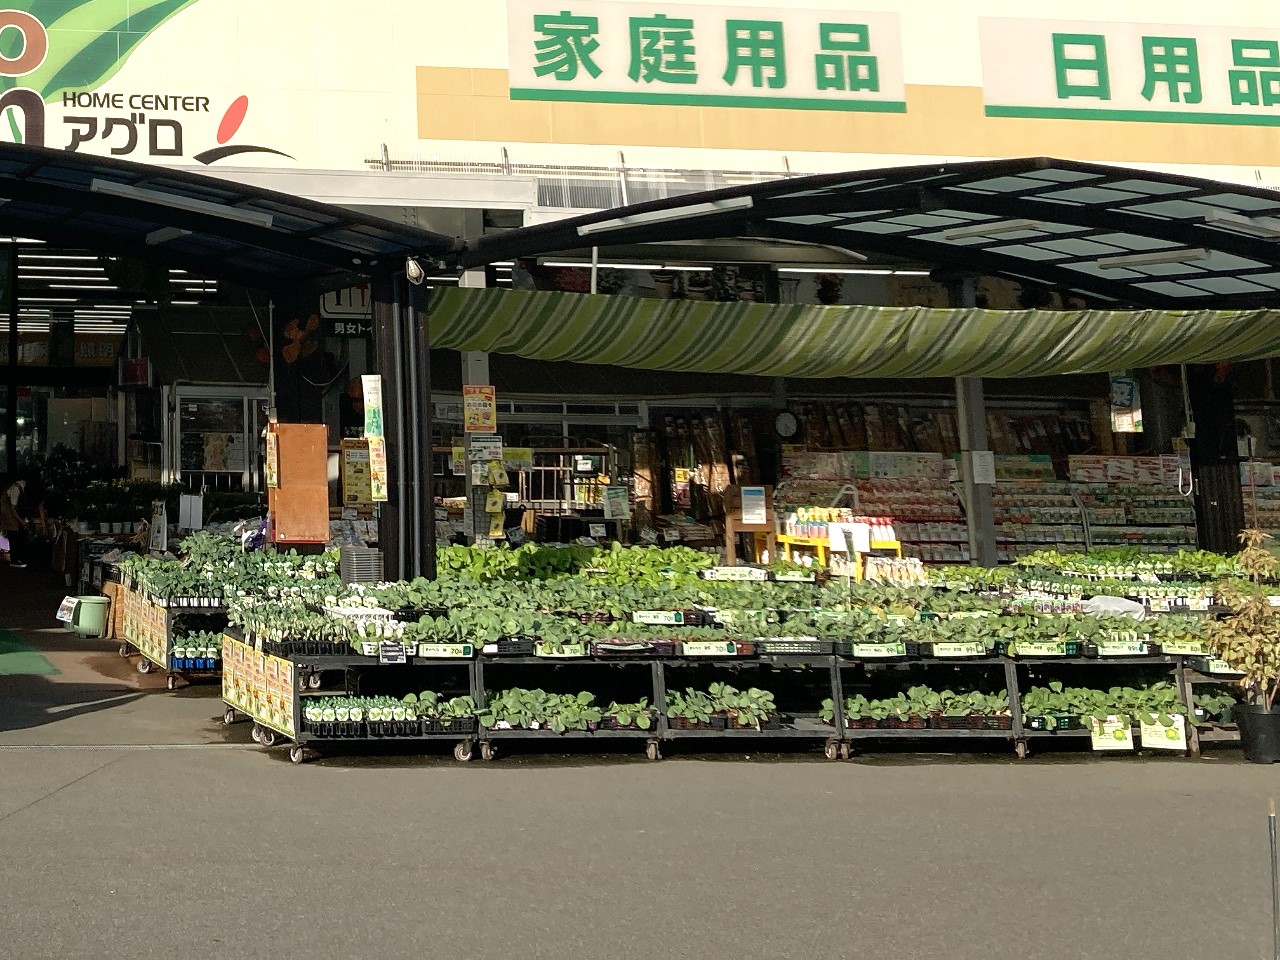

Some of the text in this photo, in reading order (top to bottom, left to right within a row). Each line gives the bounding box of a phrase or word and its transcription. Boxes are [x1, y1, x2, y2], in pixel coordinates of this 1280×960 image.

[531, 10, 881, 92] 家庭用品
[1051, 32, 1280, 107] 日用品
[63, 91, 210, 112] HOME CENTER
[63, 112, 184, 157] アグロ
